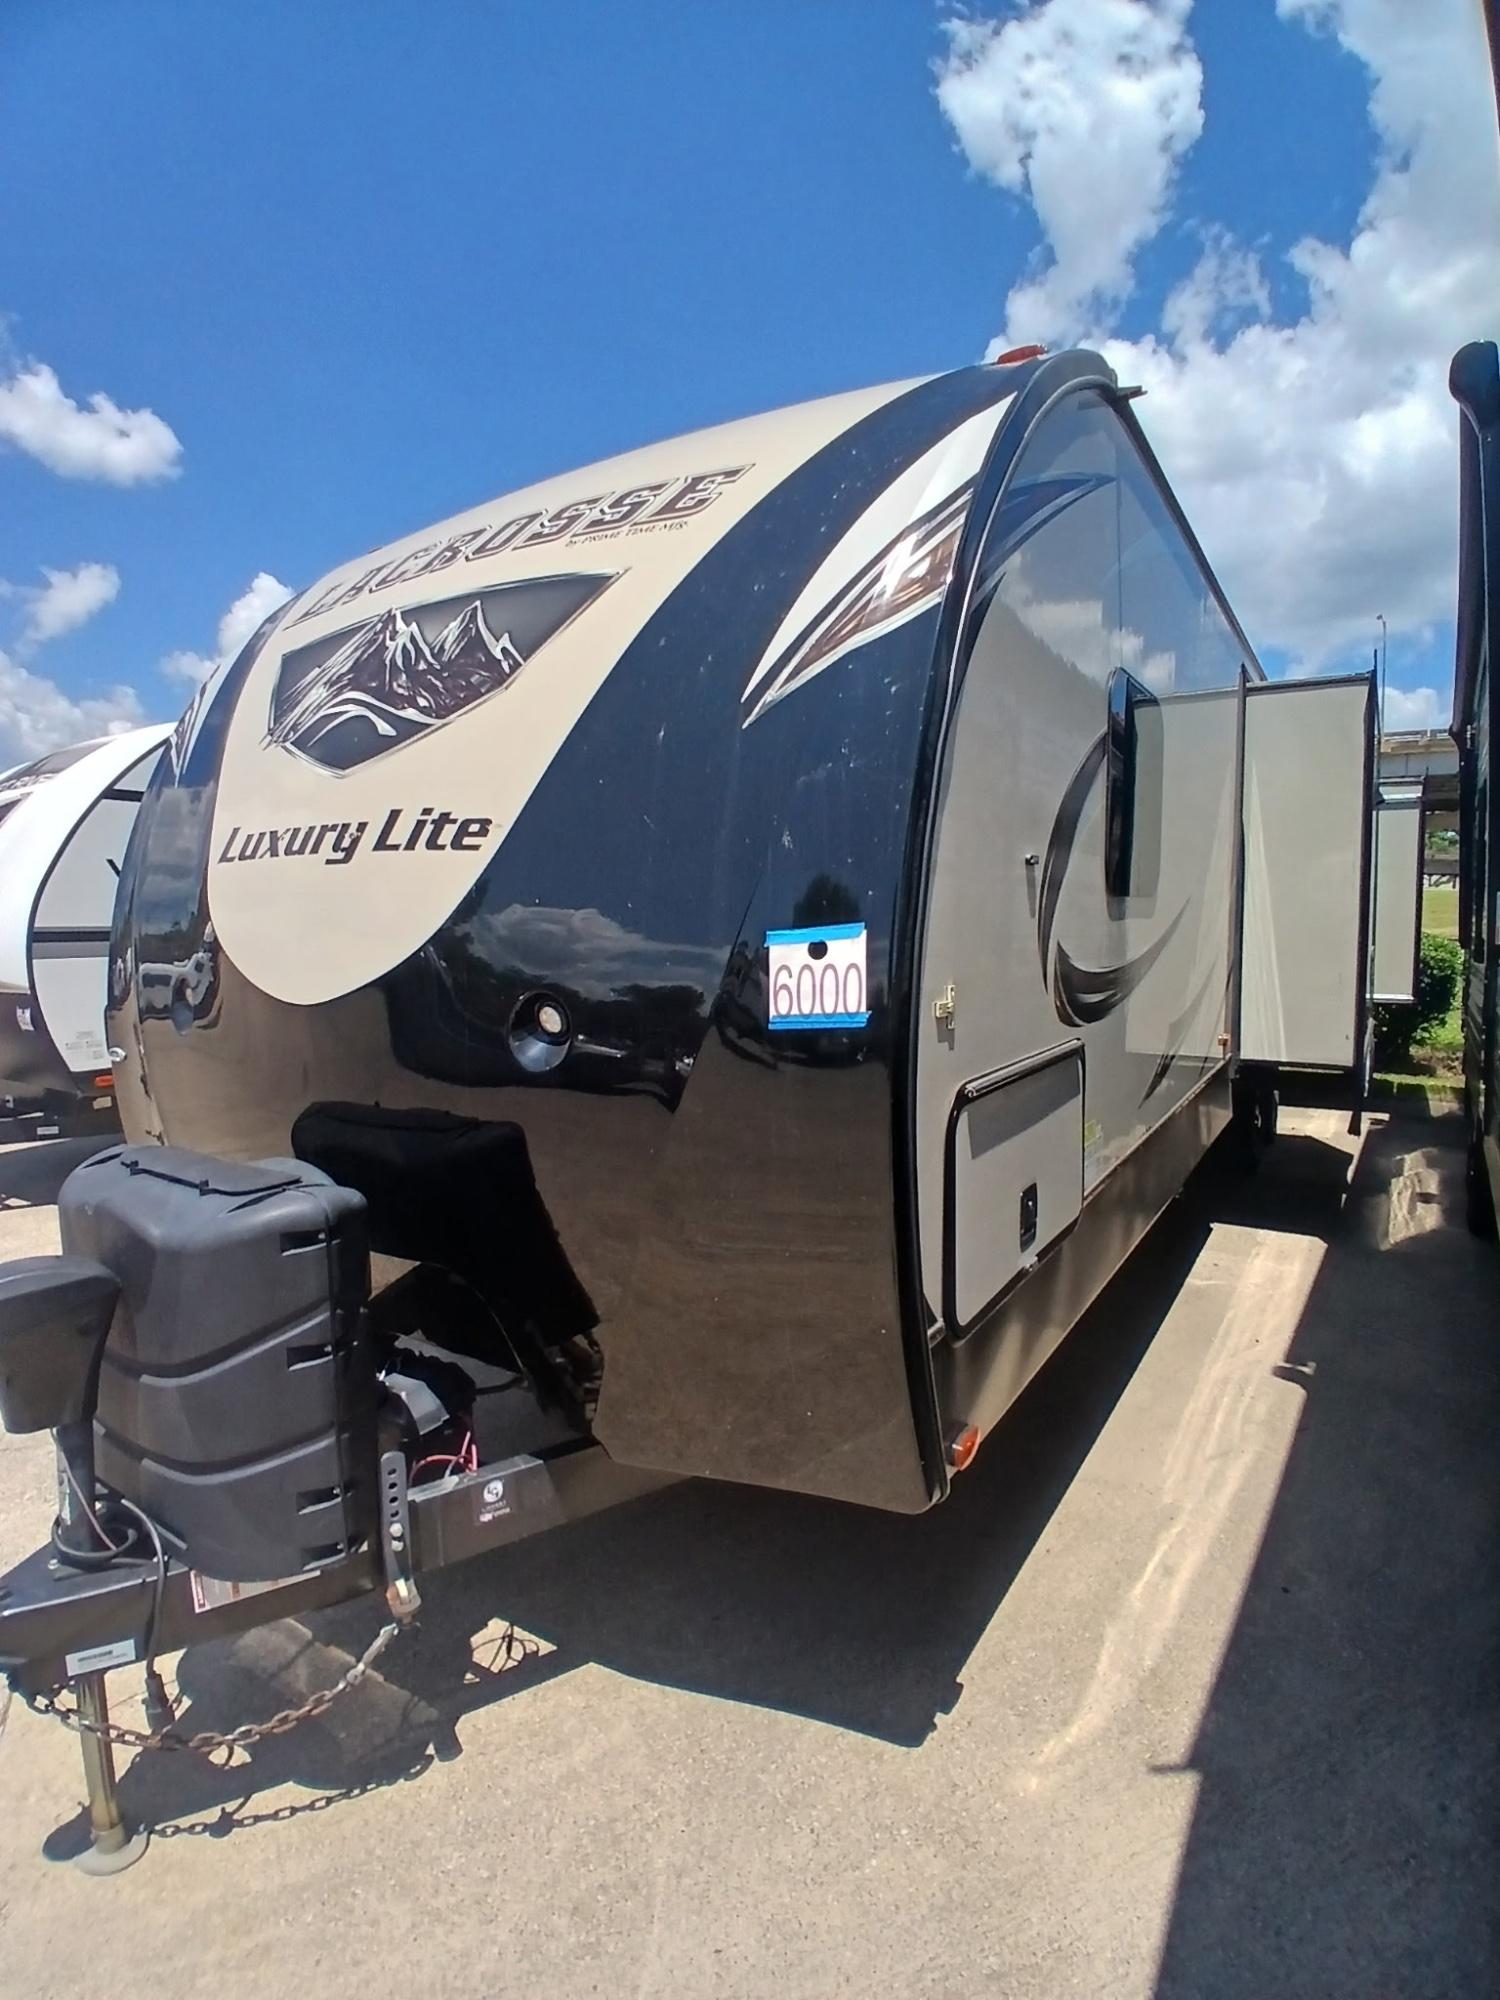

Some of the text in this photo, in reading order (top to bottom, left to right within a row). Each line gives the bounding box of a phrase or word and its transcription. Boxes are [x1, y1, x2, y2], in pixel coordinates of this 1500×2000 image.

[283, 463, 756, 631] LACROSSE
[218, 807, 493, 865] Luxury Lite
[773, 962, 862, 1018] 6000
